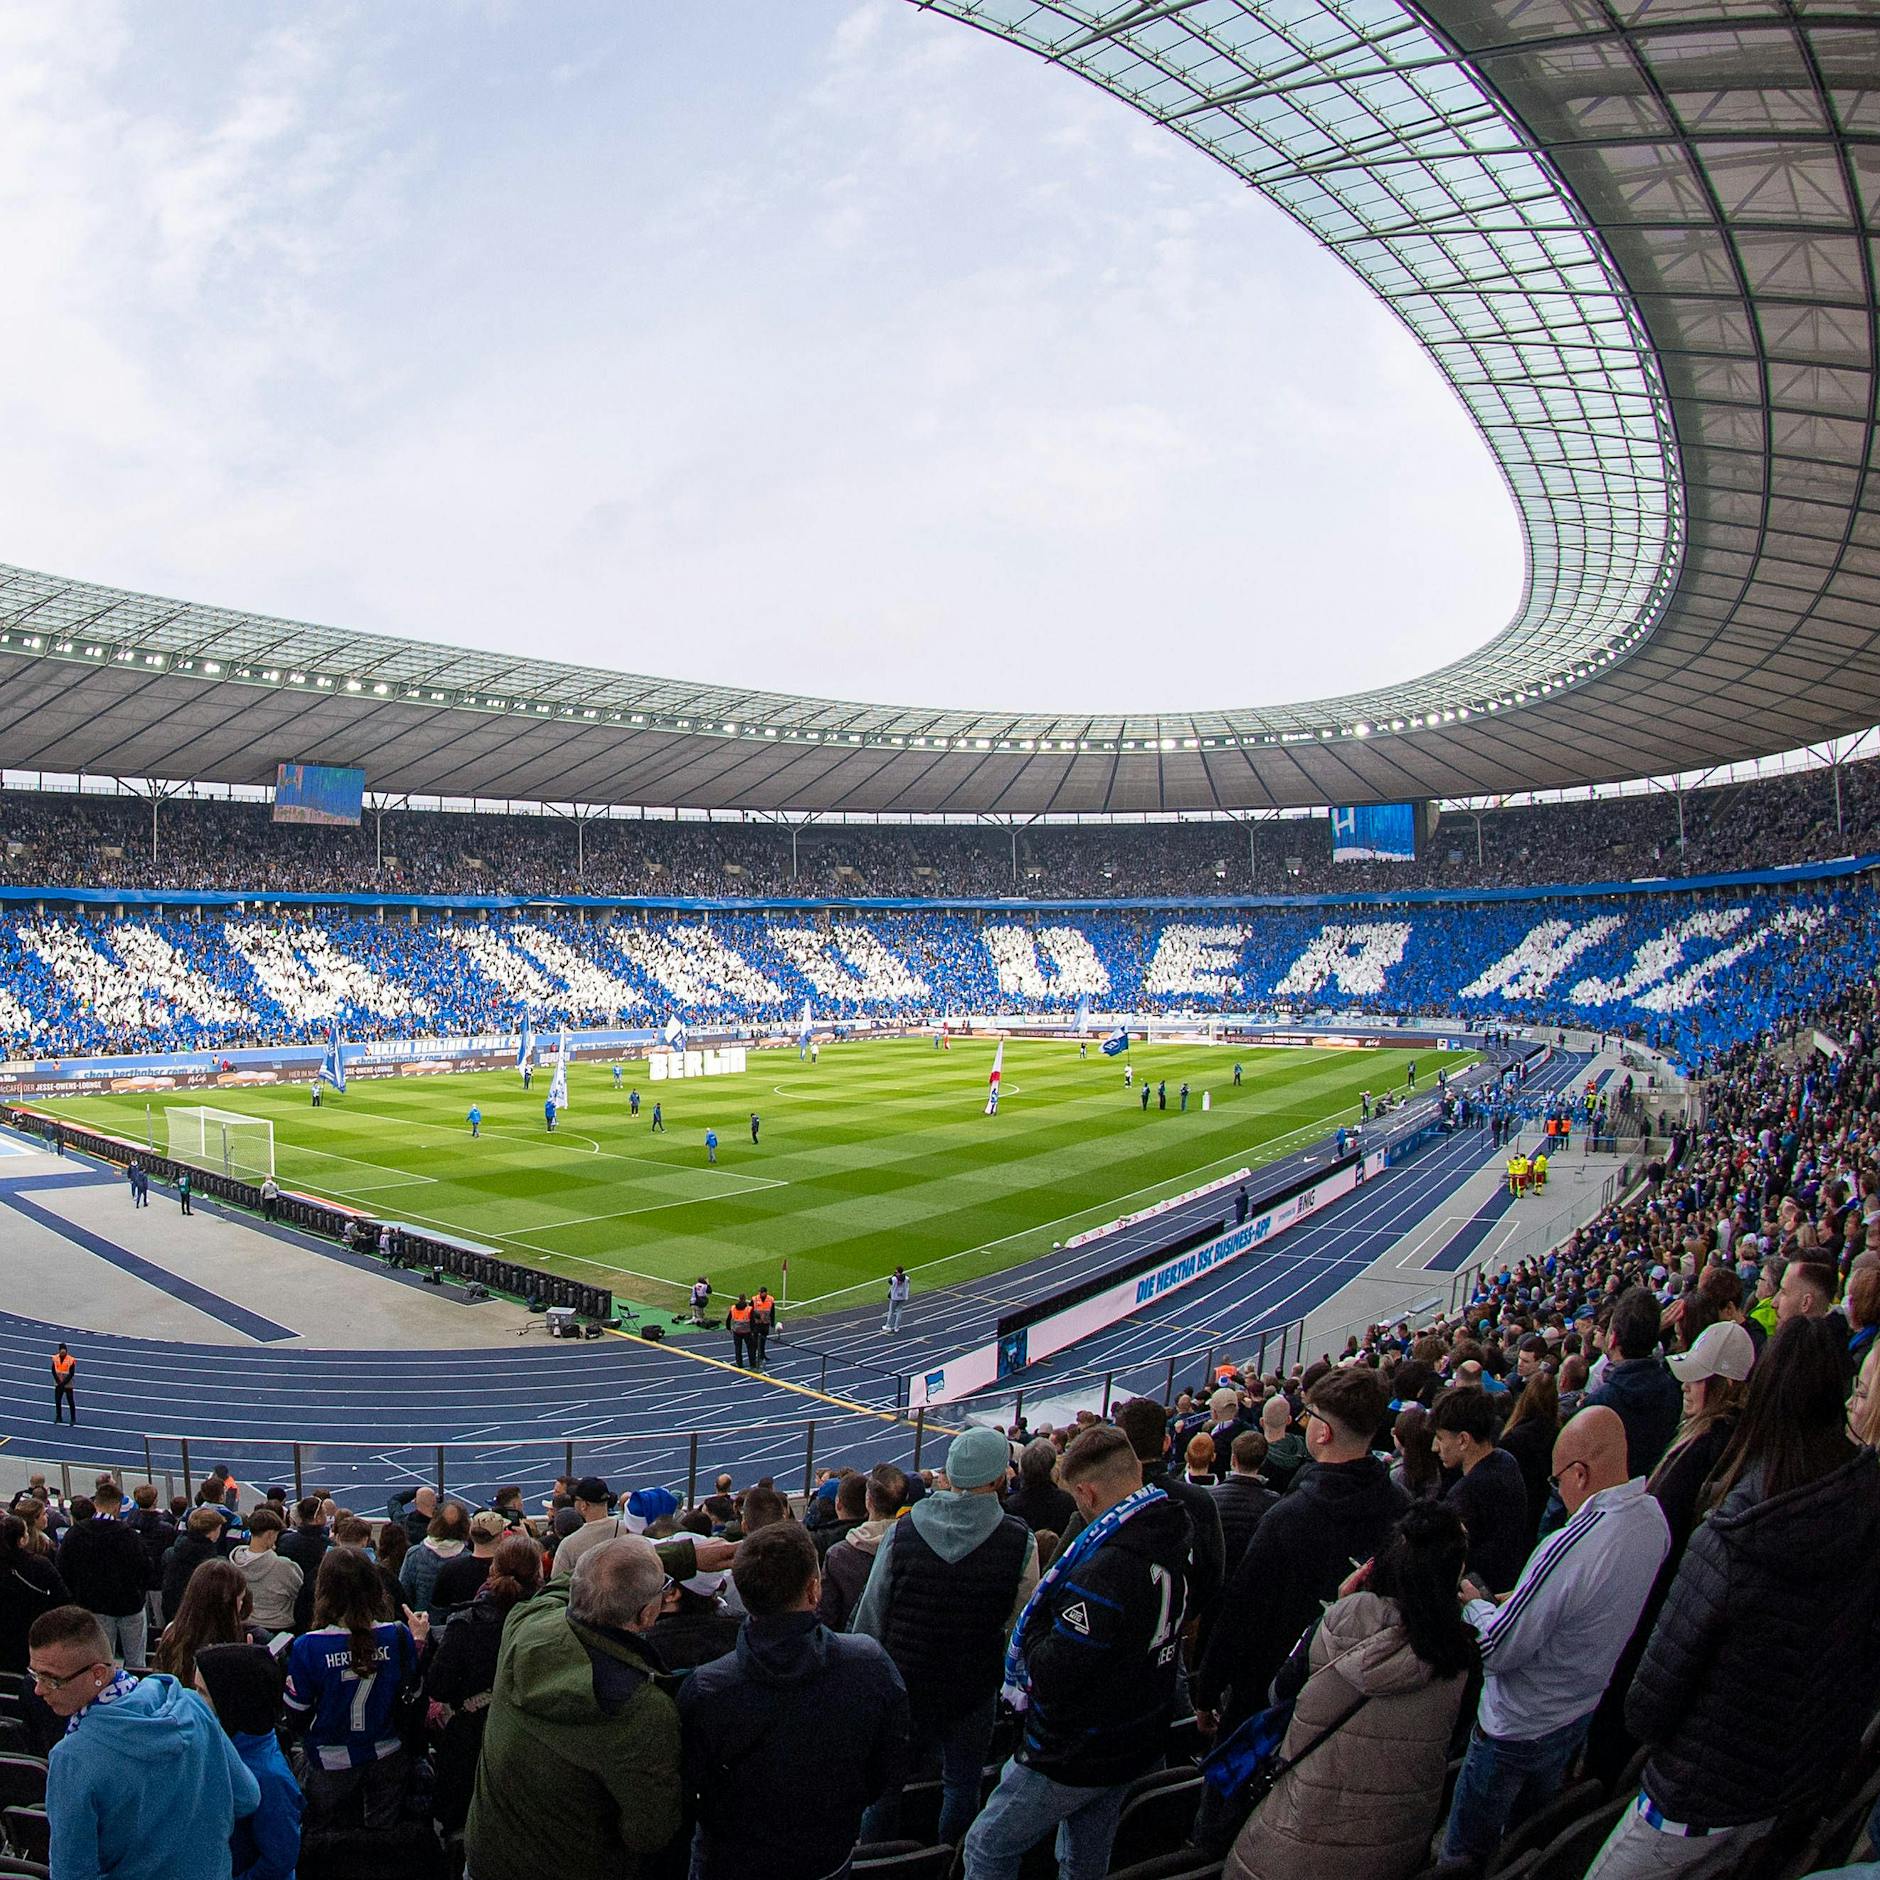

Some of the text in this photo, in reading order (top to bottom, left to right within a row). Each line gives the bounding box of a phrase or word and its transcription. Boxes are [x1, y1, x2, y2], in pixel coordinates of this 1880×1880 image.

[981, 923, 1411, 998] DER
[24, 1083, 35, 1092] DER
[649, 1047, 746, 1080] BERLIN
[1136, 1216, 1271, 1304] DIE HERTHA BSC BUSINESS-APP
[341, 1669, 378, 1731] 7
